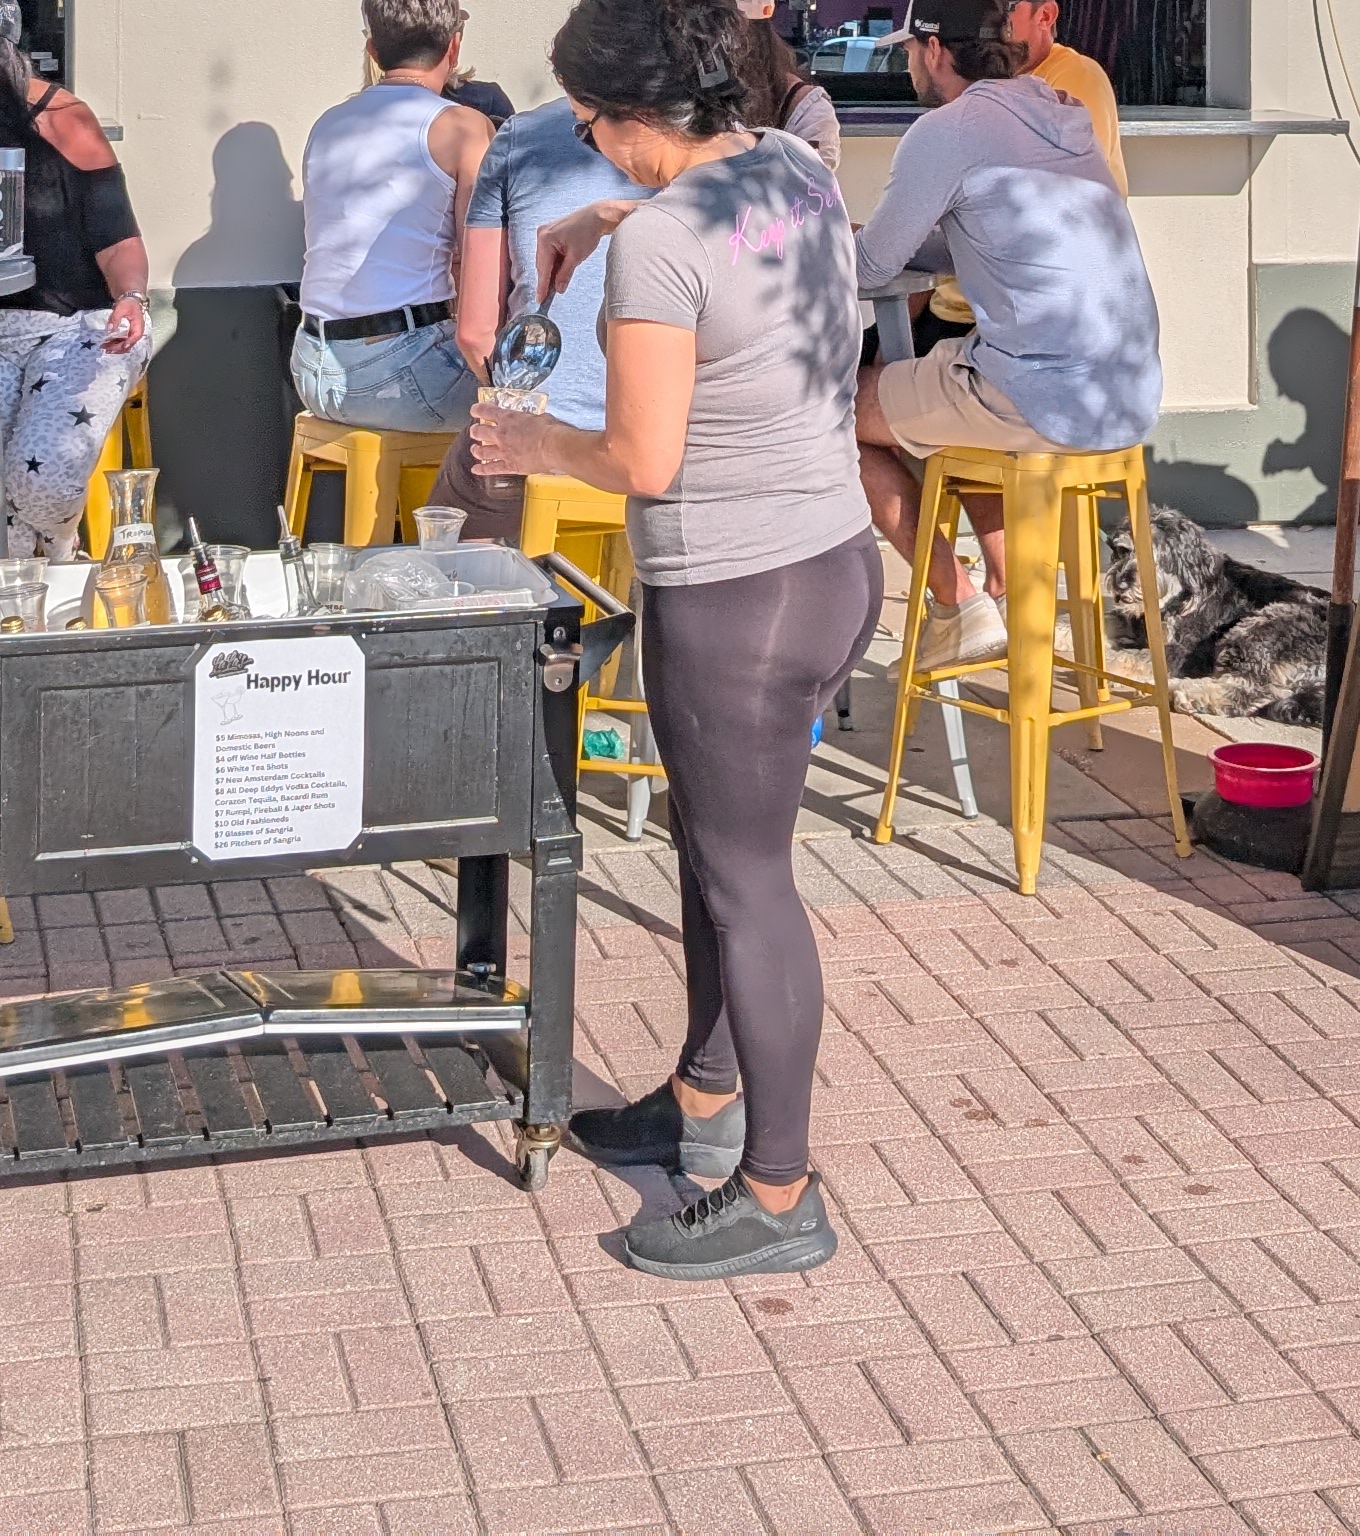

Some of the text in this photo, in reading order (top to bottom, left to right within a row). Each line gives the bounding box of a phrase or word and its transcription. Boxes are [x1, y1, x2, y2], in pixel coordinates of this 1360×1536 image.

[728, 205, 785, 266] Keep
[790, 196, 805, 228] it
[246, 669, 351, 692] Happy Hour
[265, 731, 282, 739] High
[244, 774, 288, 782] Amsterdam
[291, 771, 325, 779] Cocktails
[265, 826, 293, 835] Sangria
[273, 836, 301, 844] Sangria
